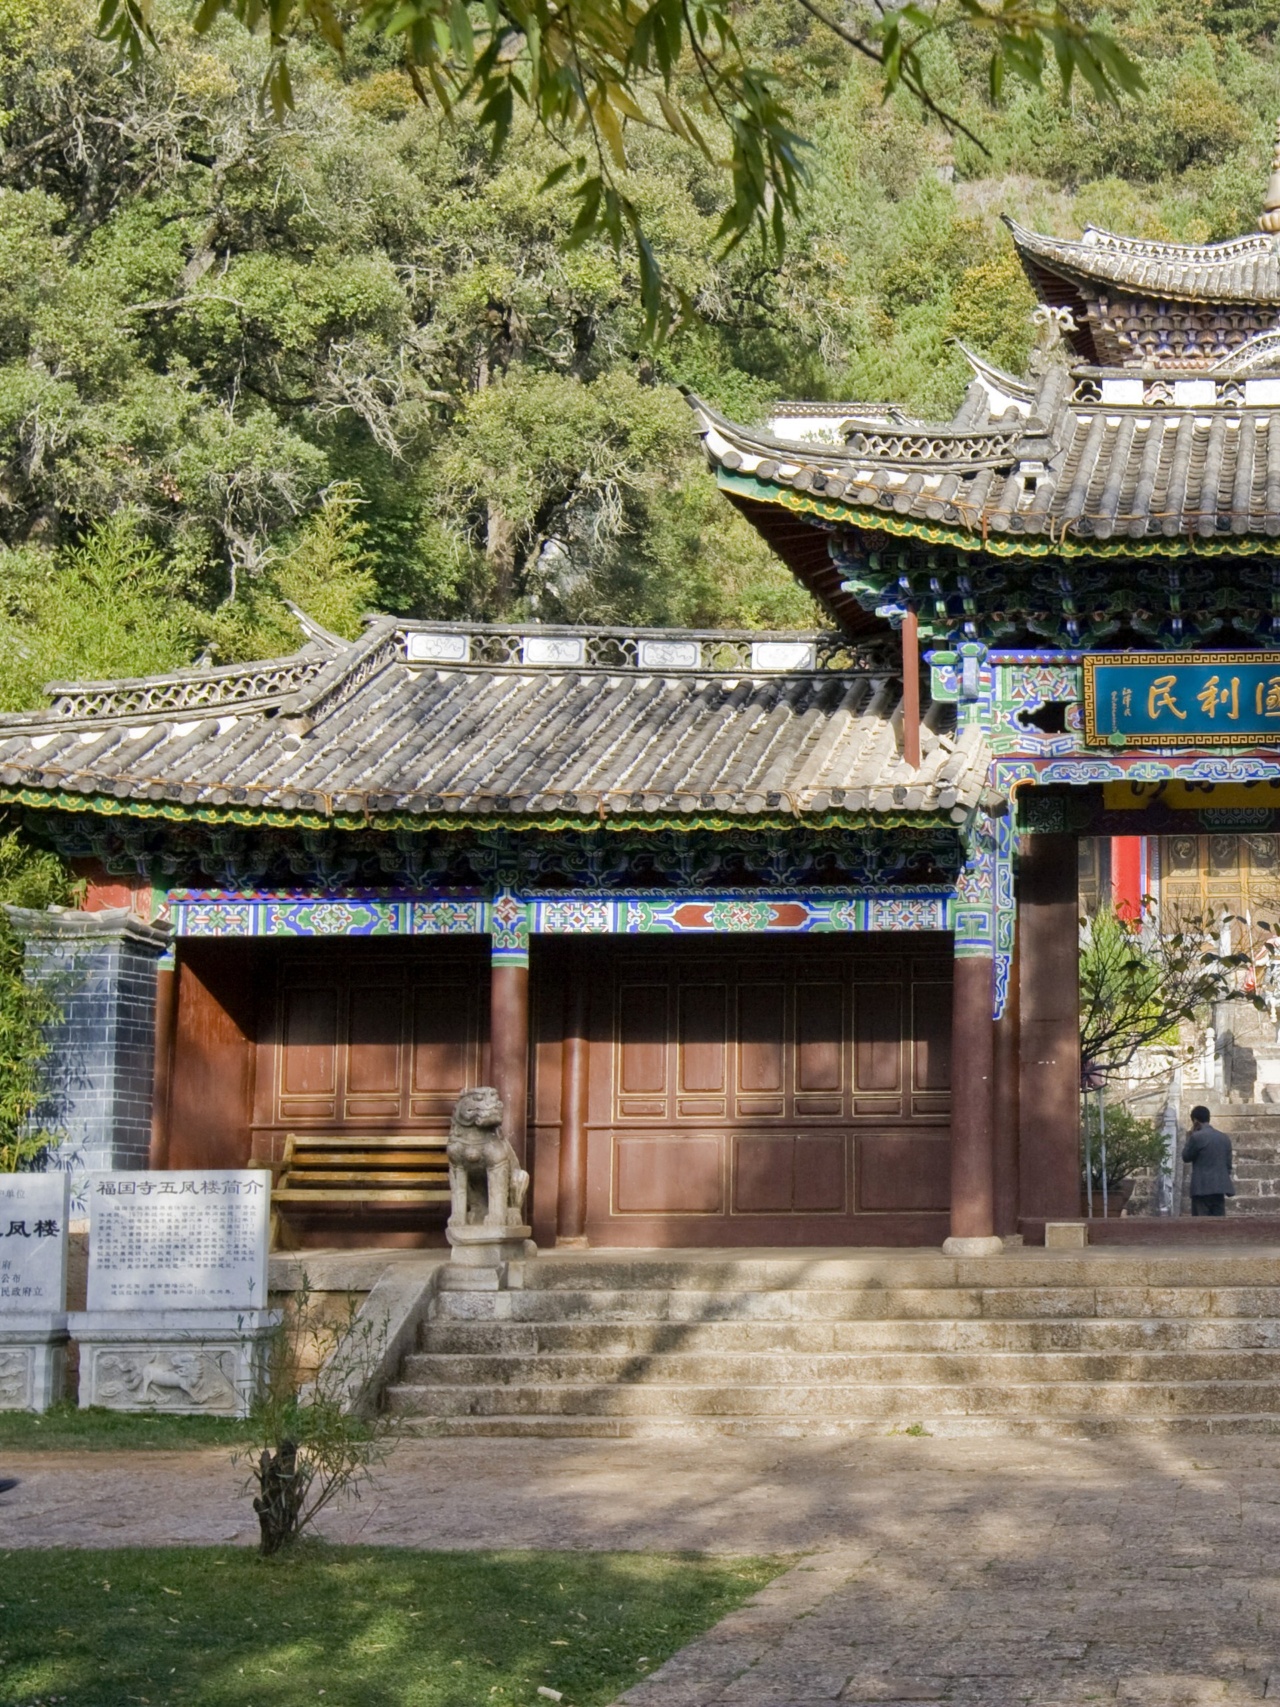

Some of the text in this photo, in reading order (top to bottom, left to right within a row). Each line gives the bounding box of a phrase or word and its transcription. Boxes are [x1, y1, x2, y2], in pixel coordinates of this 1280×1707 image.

[96, 1180, 264, 1196] 福国寺五凤楼简介
[0, 1219, 60, 1238] 凤楼
